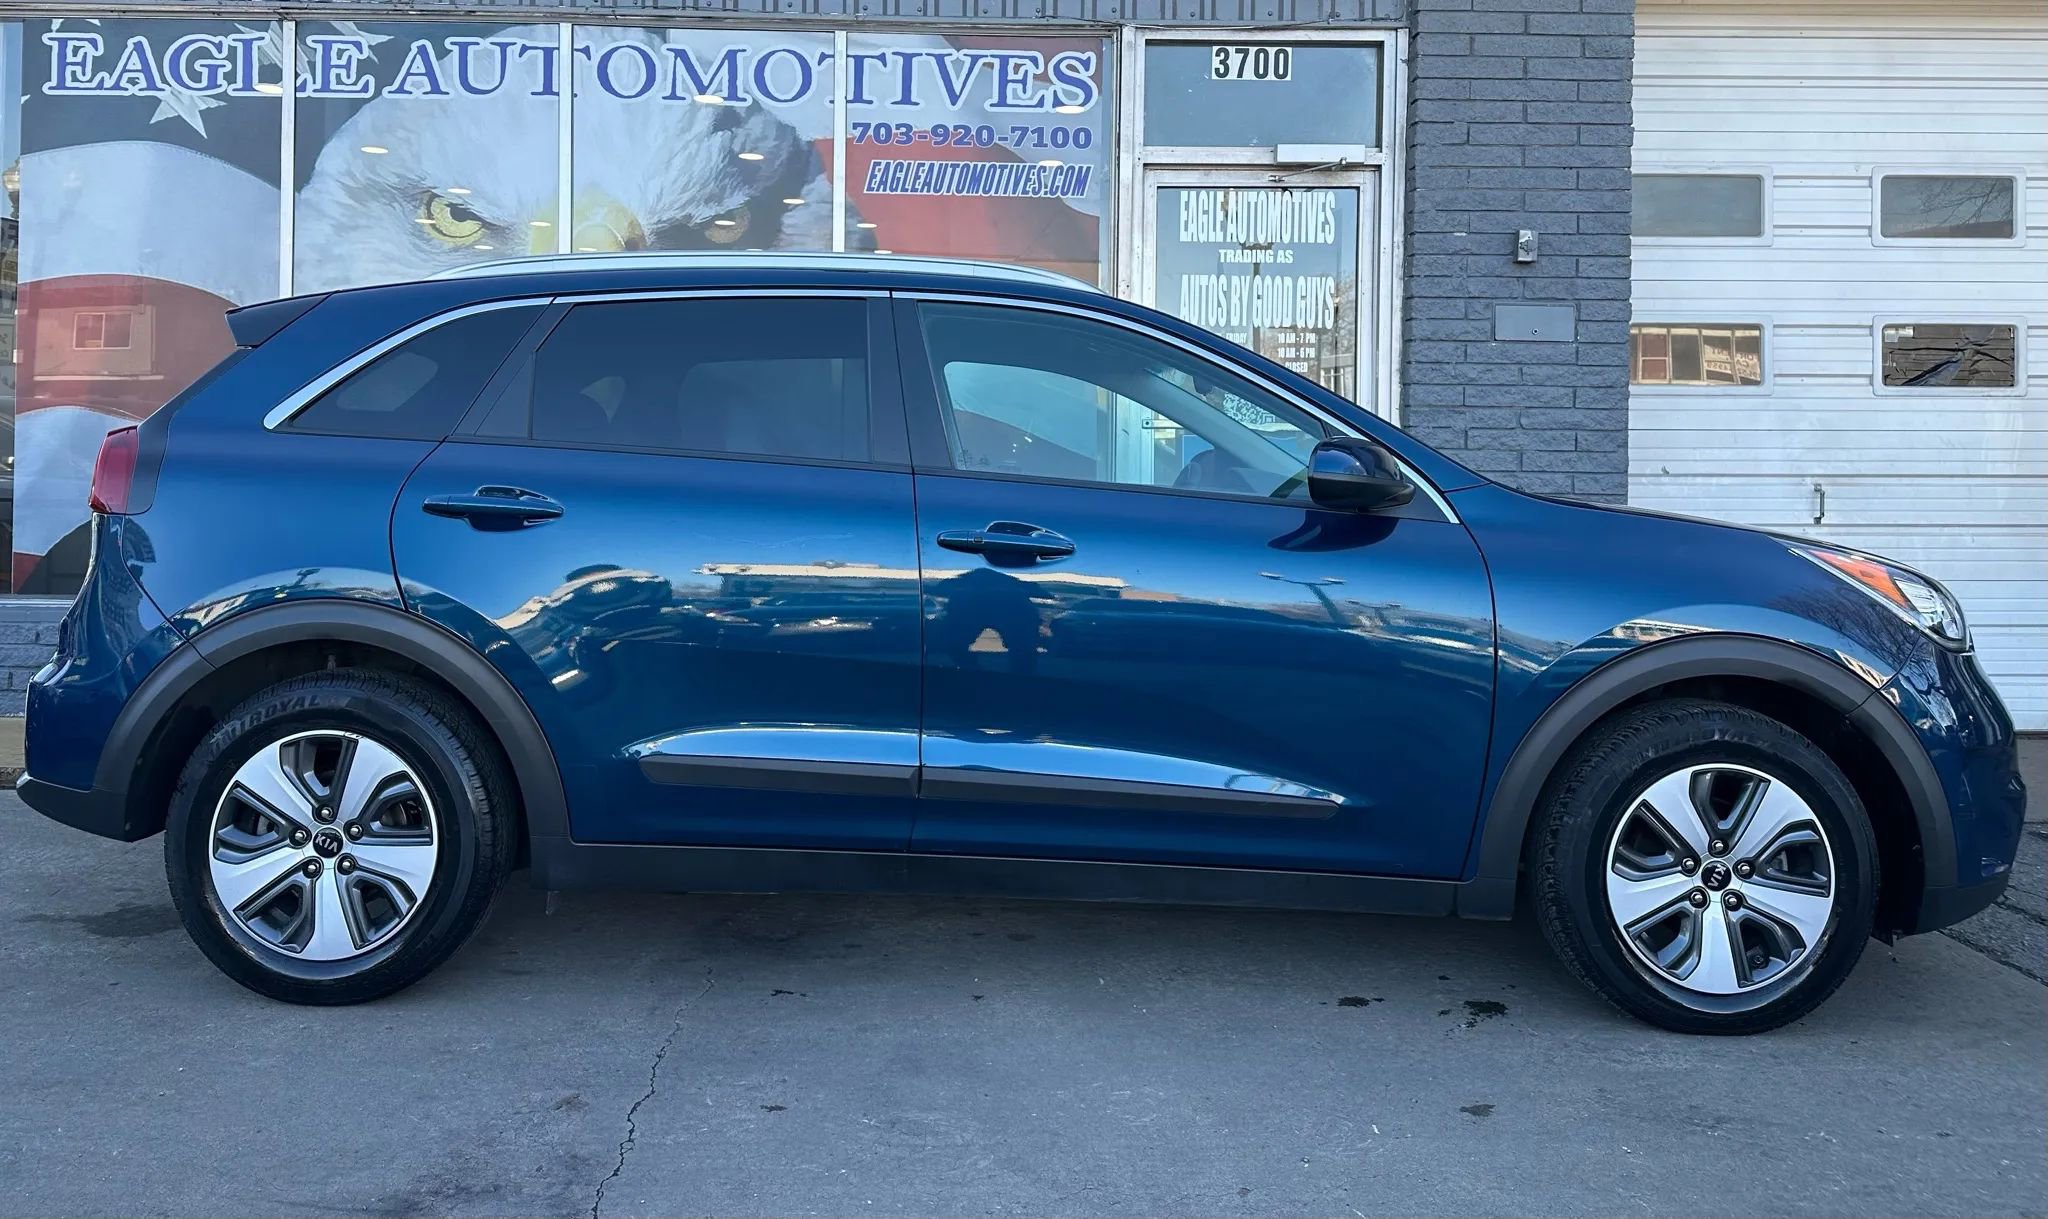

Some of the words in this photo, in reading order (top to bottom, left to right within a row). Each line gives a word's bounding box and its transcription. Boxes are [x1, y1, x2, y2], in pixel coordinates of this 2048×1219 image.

[43, 32, 374, 97] EAGLE
[386, 38, 1097, 110] AUTOMOTIVES
[1214, 47, 1290, 80] 3700
[852, 121, 1093, 150] 703-920-7100
[866, 161, 1092, 197] EAGLEAUTOMOTIVES.COM
[1179, 190, 1225, 243] EAGLE
[1226, 190, 1336, 244] AUTOMOTIVES
[1218, 249, 1274, 264] TRADING
[1276, 249, 1294, 264] AS
[1179, 274, 1228, 328] AUTOS
[1230, 275, 1250, 327] BY
[1252, 274, 1293, 329] GOOD
[1295, 275, 1335, 329] GUYS
[1225, 332, 1247, 344] FRIDAY
[1278, 332, 1285, 344] 10
[1285, 332, 1296, 344] AM
[1305, 332, 1316, 344] PM
[1285, 347, 1296, 358] AM
[1305, 347, 1316, 358] PM
[1285, 361, 1308, 373] CLOSED
[315, 833, 338, 853] KIA
[1707, 863, 1727, 887] KIA
